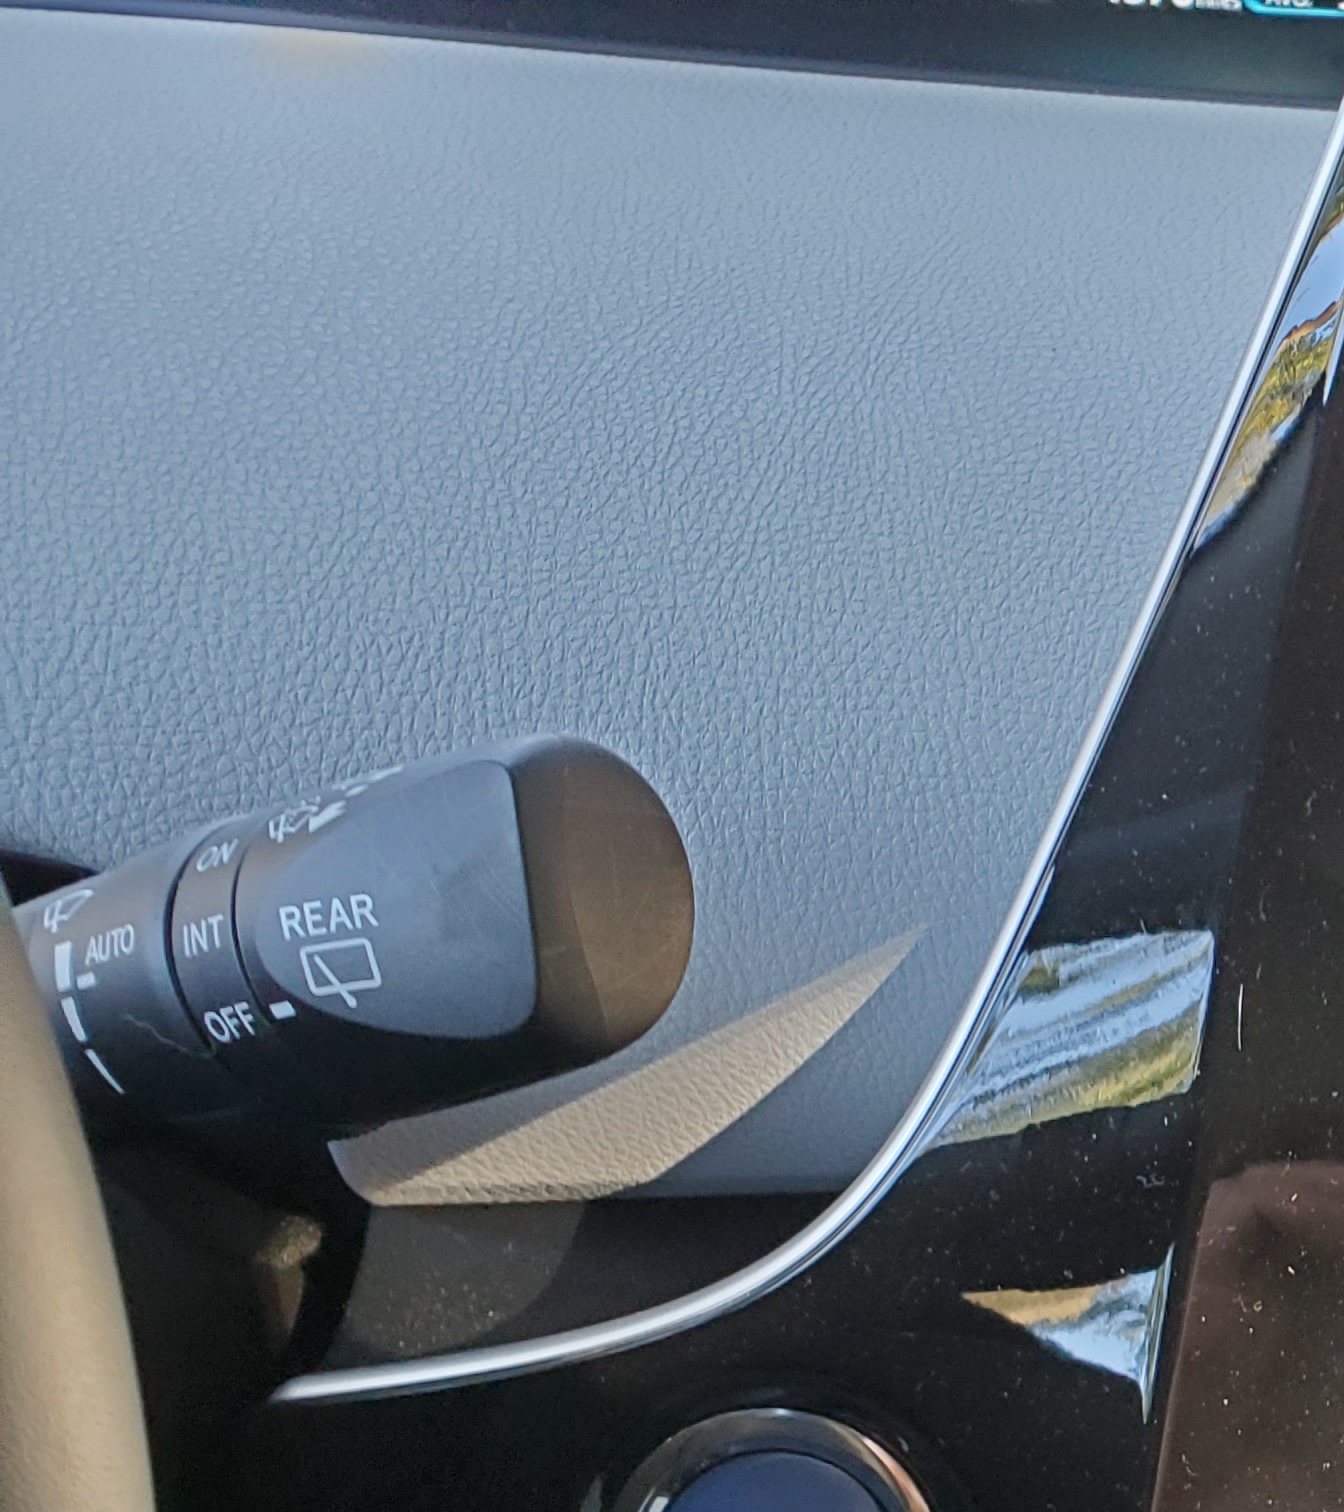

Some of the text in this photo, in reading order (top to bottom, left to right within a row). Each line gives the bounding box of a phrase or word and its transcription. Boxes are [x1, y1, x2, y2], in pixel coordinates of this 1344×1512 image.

[196, 838, 239, 873] ON
[182, 915, 224, 958] INT
[279, 894, 379, 942] REAR
[85, 923, 135, 965] AUTO
[204, 1001, 256, 1044] OFF
